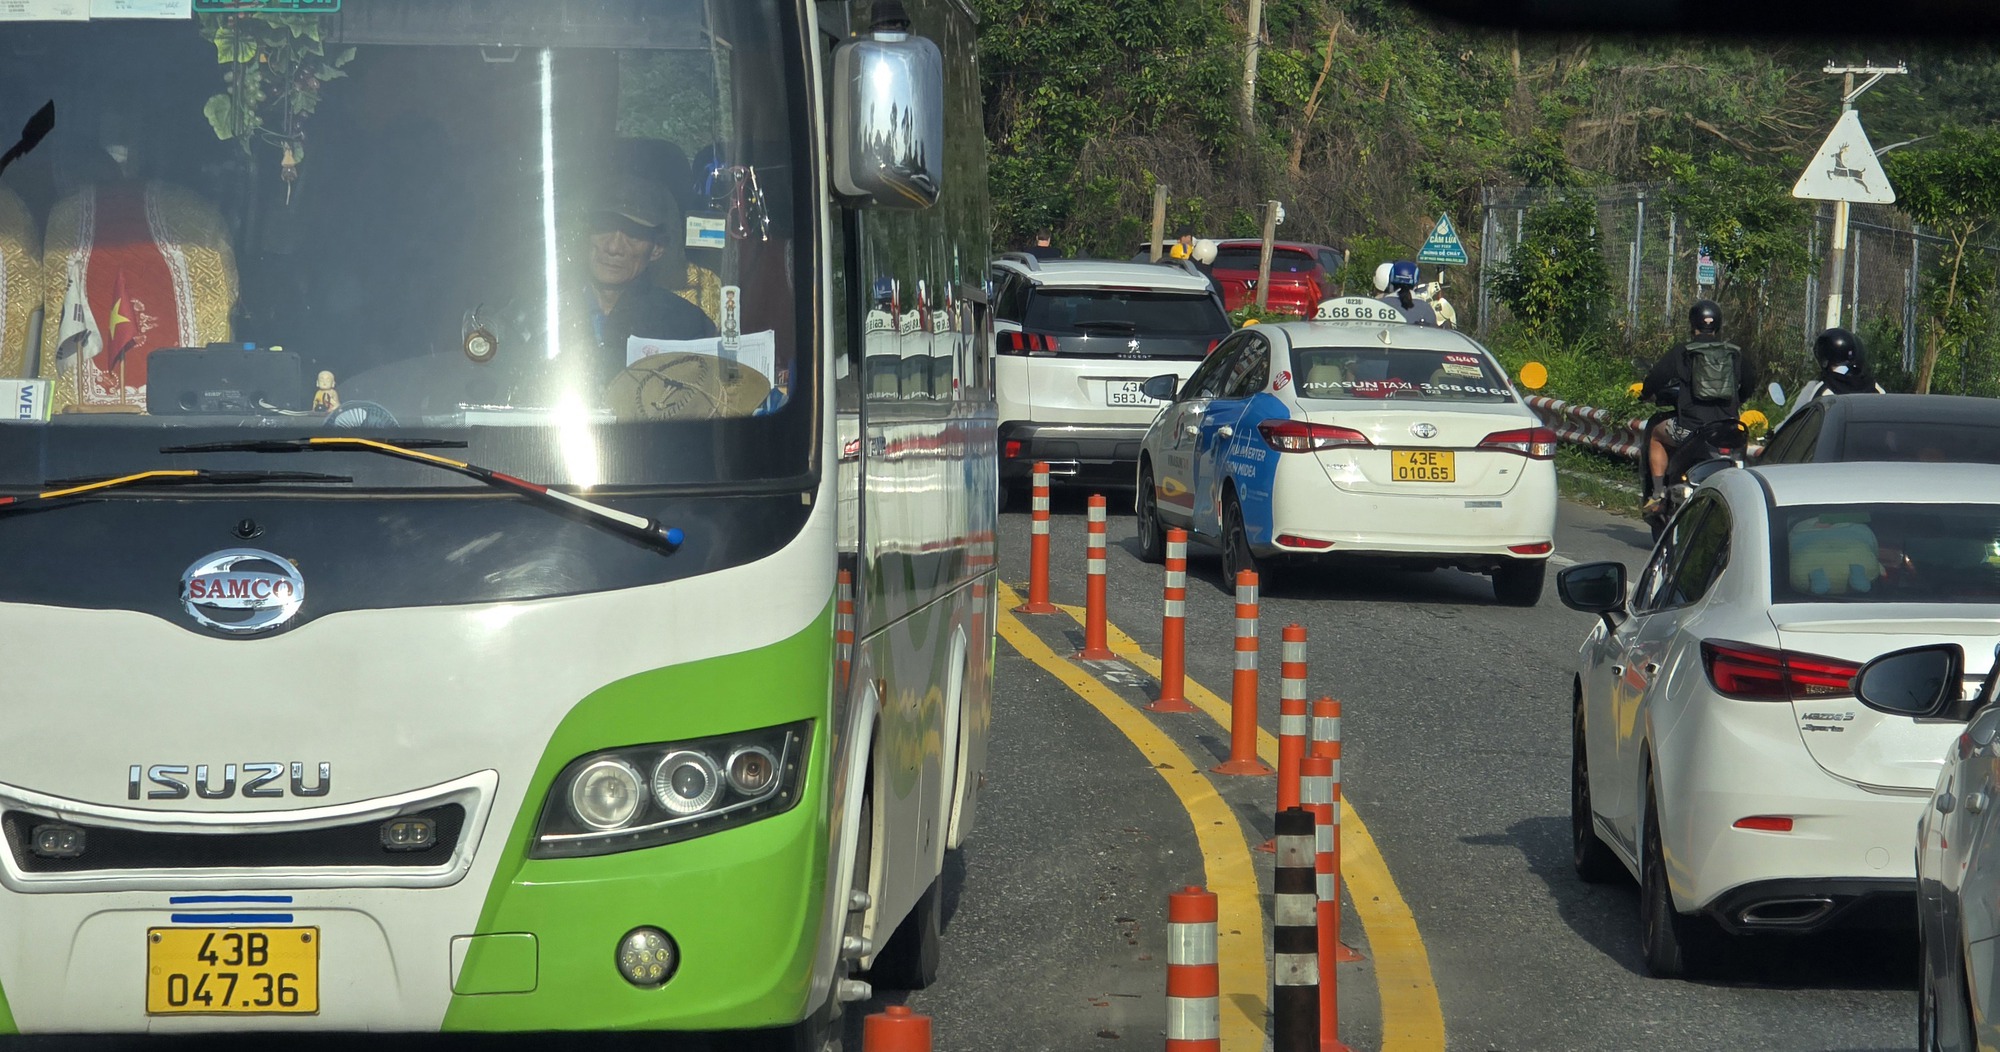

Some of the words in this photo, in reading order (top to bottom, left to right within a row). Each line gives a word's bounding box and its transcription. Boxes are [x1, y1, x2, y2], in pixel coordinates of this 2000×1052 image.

[1318, 307, 1349, 318] 3.68
[1355, 307, 1373, 318] 68
[1379, 308, 1396, 320] 68
[1420, 383, 1462, 391] 3.68
[1464, 385, 1488, 394] 68
[1489, 388, 1511, 396] 68
[1409, 452, 1437, 465] 43E
[1399, 466, 1448, 480] 010.65
[190, 578, 294, 599] SAMCO
[128, 761, 331, 800] ISUZU
[197, 932, 269, 967] 43B
[167, 972, 299, 1007] 047.36
